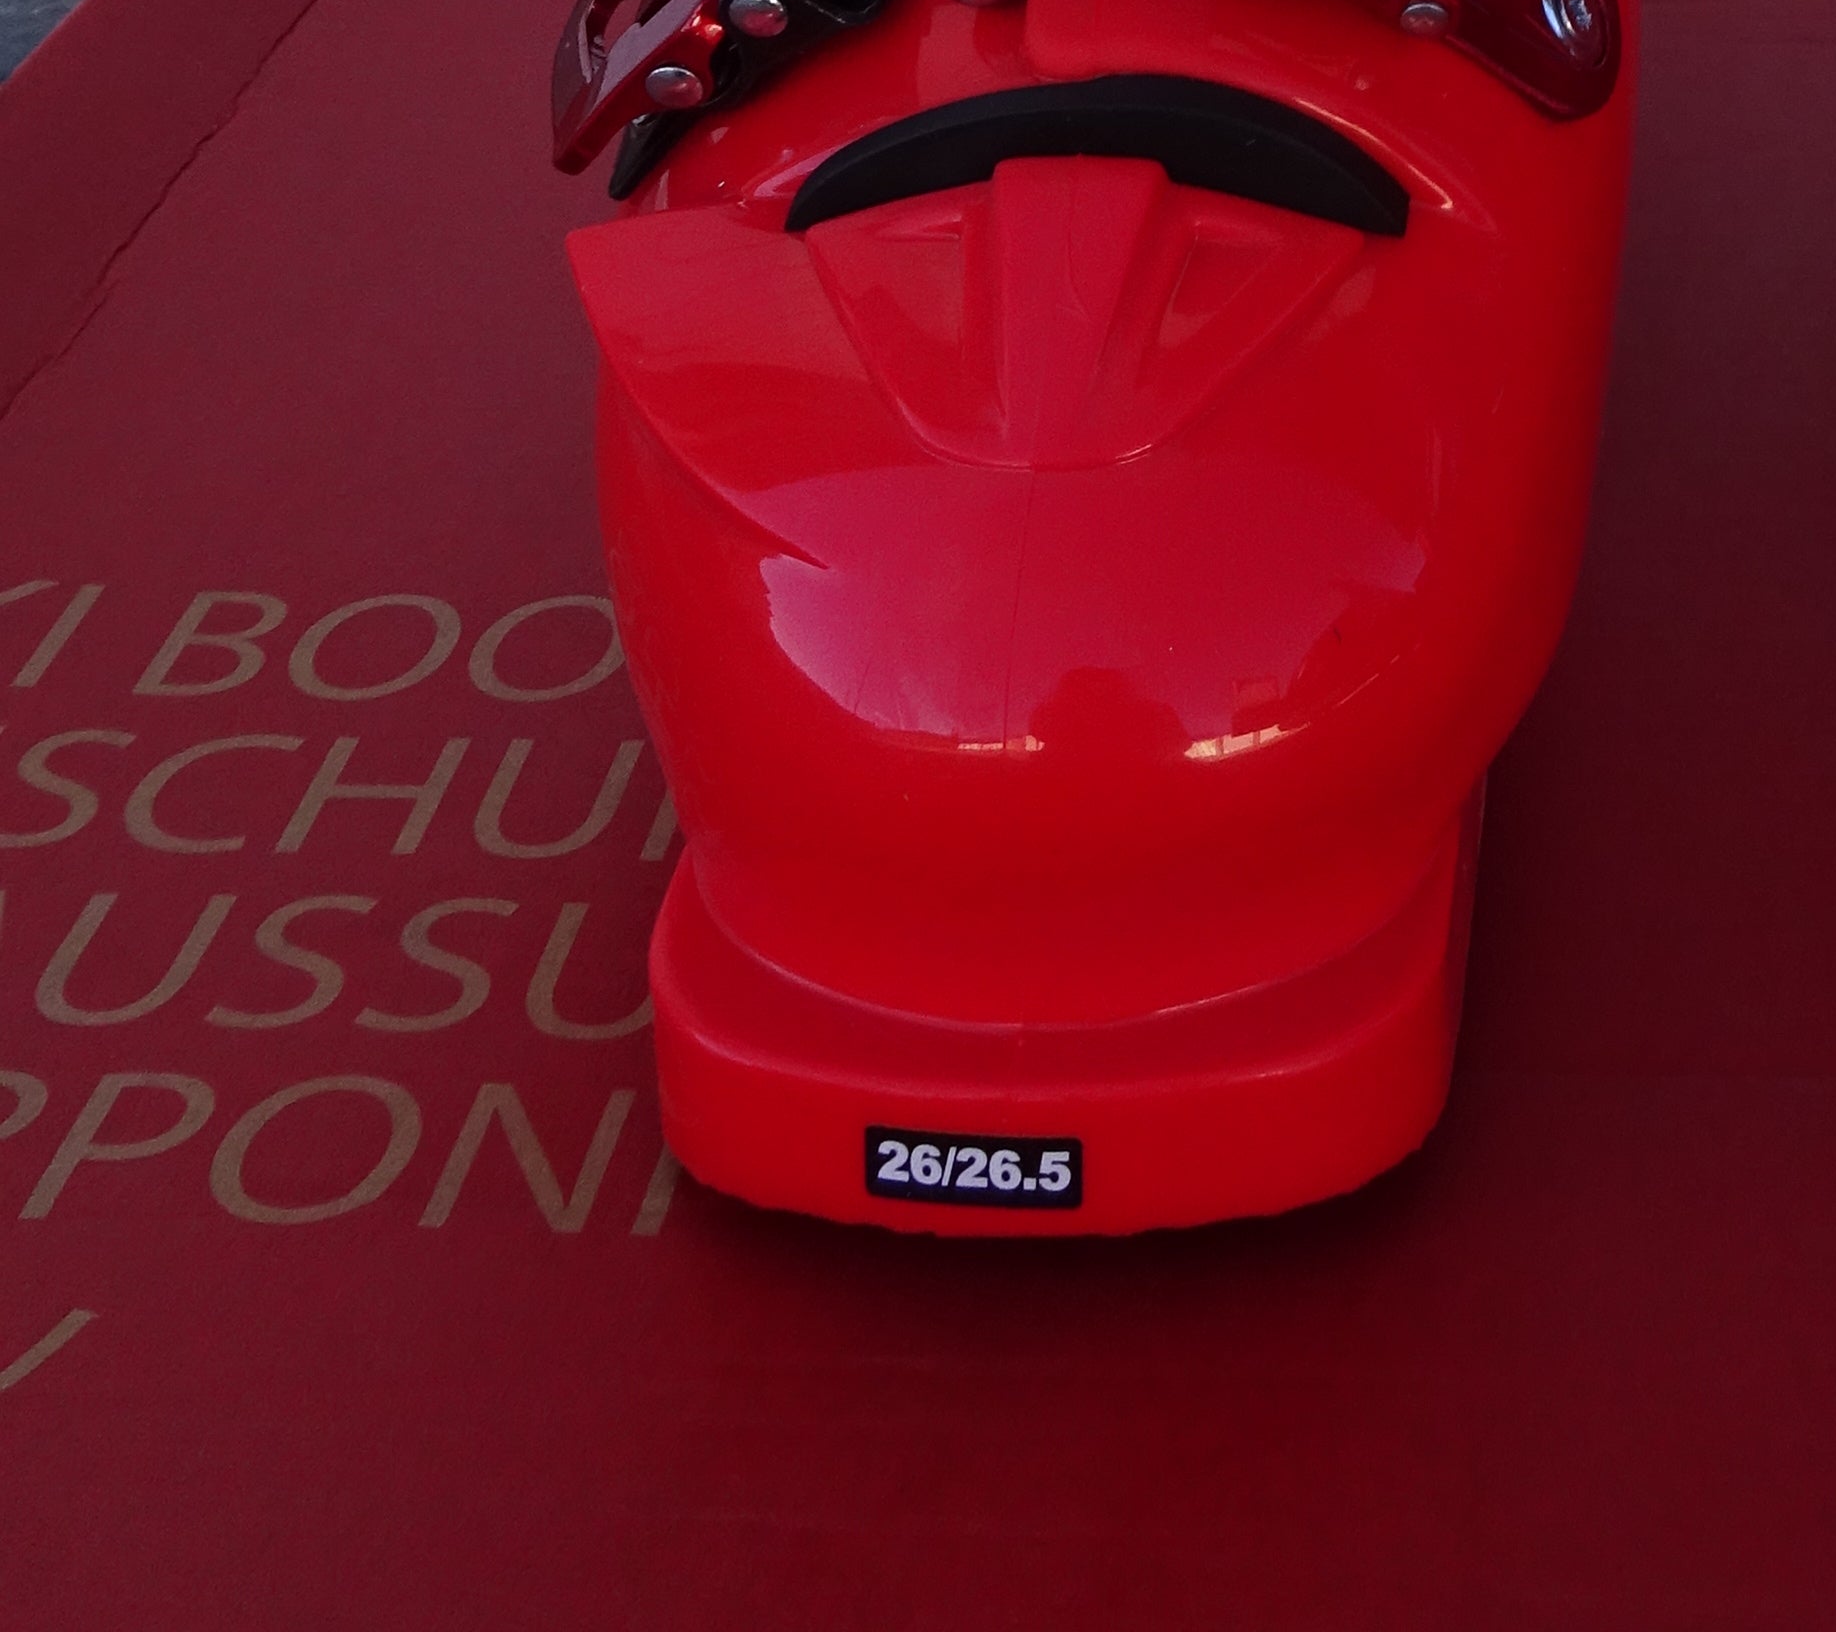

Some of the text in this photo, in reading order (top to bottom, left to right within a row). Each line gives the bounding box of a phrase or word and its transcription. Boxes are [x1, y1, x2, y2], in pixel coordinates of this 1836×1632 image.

[132, 591, 625, 703] BOO
[0, 727, 684, 862] SCHU
[0, 891, 654, 1040] USSU
[877, 1139, 1072, 1192] 26/26.5
